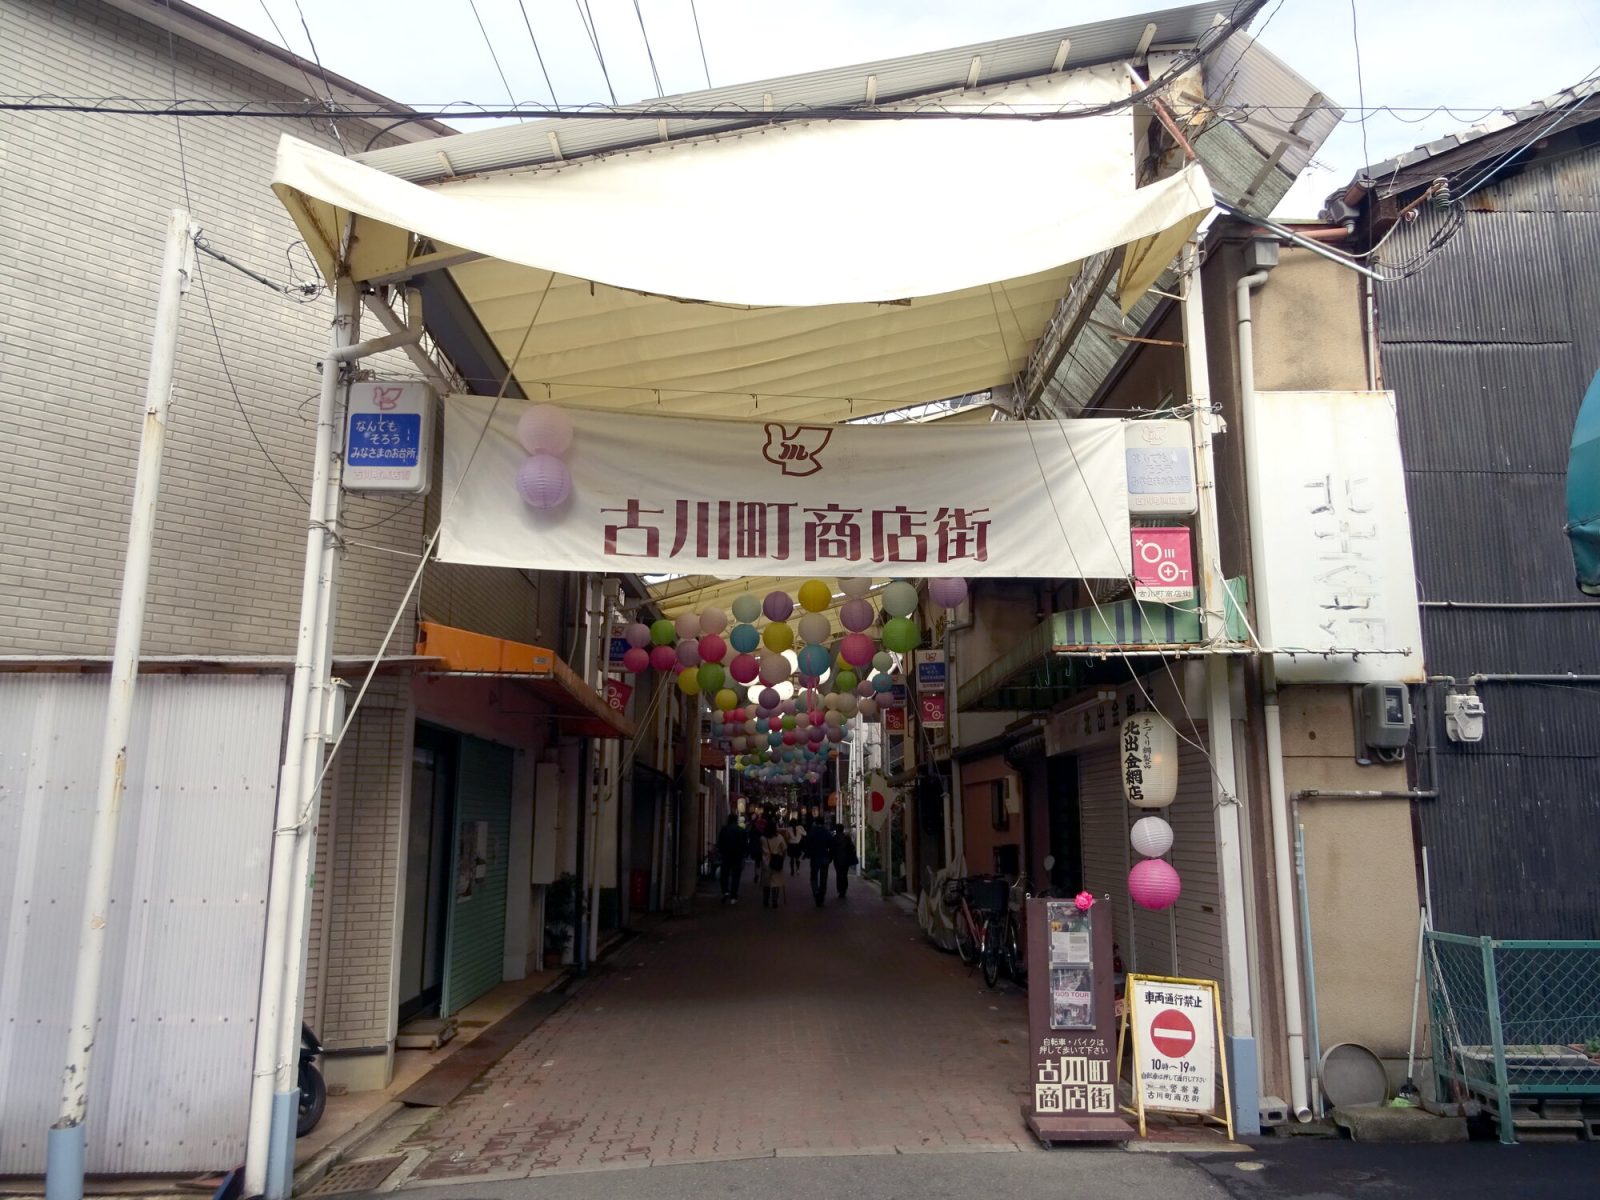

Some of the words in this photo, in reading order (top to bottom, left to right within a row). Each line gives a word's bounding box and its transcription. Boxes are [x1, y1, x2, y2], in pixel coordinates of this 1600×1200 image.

[356, 420, 398, 432] なんでも
[350, 447, 417, 459] みなさまのお台所
[600, 498, 991, 563] 古川町商店街
[1123, 720, 1144, 801] 北出金網店
[1144, 991, 1203, 1008] 車両通行禁止
[1043, 1037, 1104, 1047] 自転車・バイクは
[1039, 1046, 1109, 1055] 押して歩いて下さい
[1037, 1059, 1111, 1083] 古川町
[1037, 1086, 1112, 1110] 商店街
[1147, 1090, 1200, 1103] 古川町商店街
